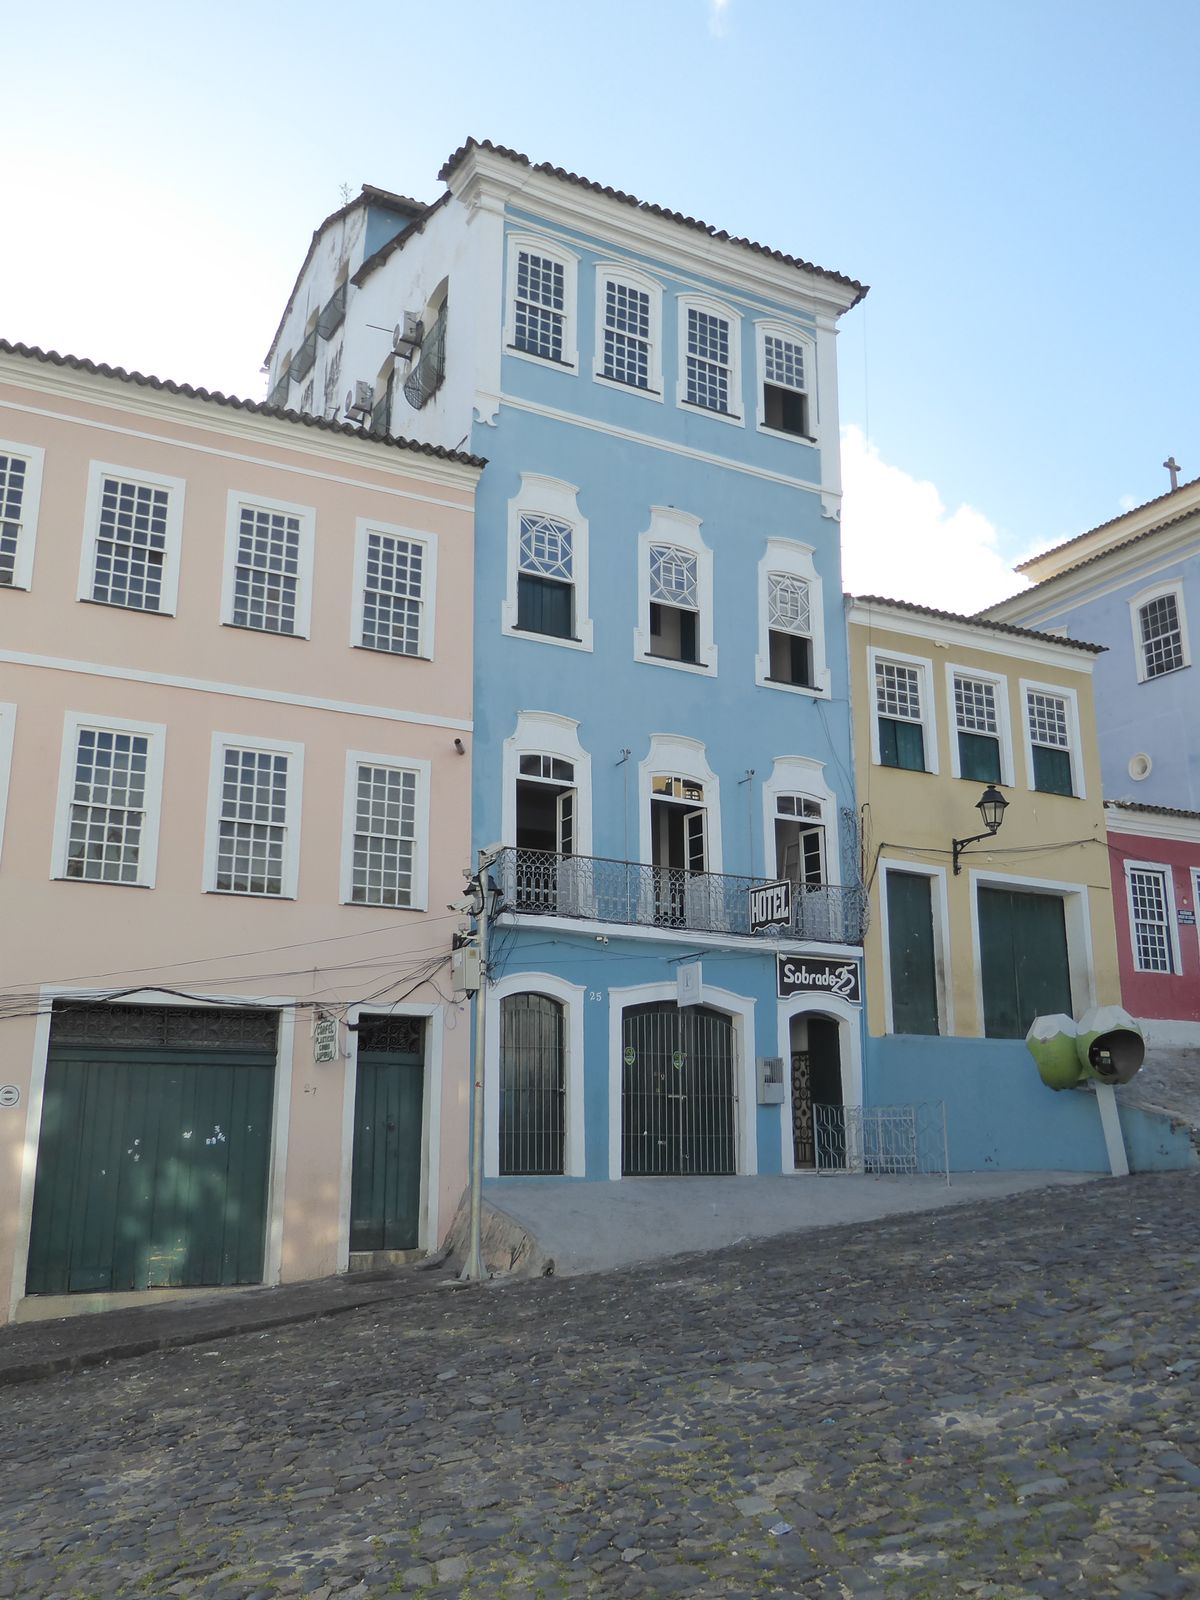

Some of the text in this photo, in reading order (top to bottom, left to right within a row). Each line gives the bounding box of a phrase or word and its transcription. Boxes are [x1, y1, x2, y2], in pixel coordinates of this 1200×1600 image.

[751, 885, 789, 924] HOTEL
[783, 963, 856, 995] Sobrado 25
[589, 991, 602, 1002] 25
